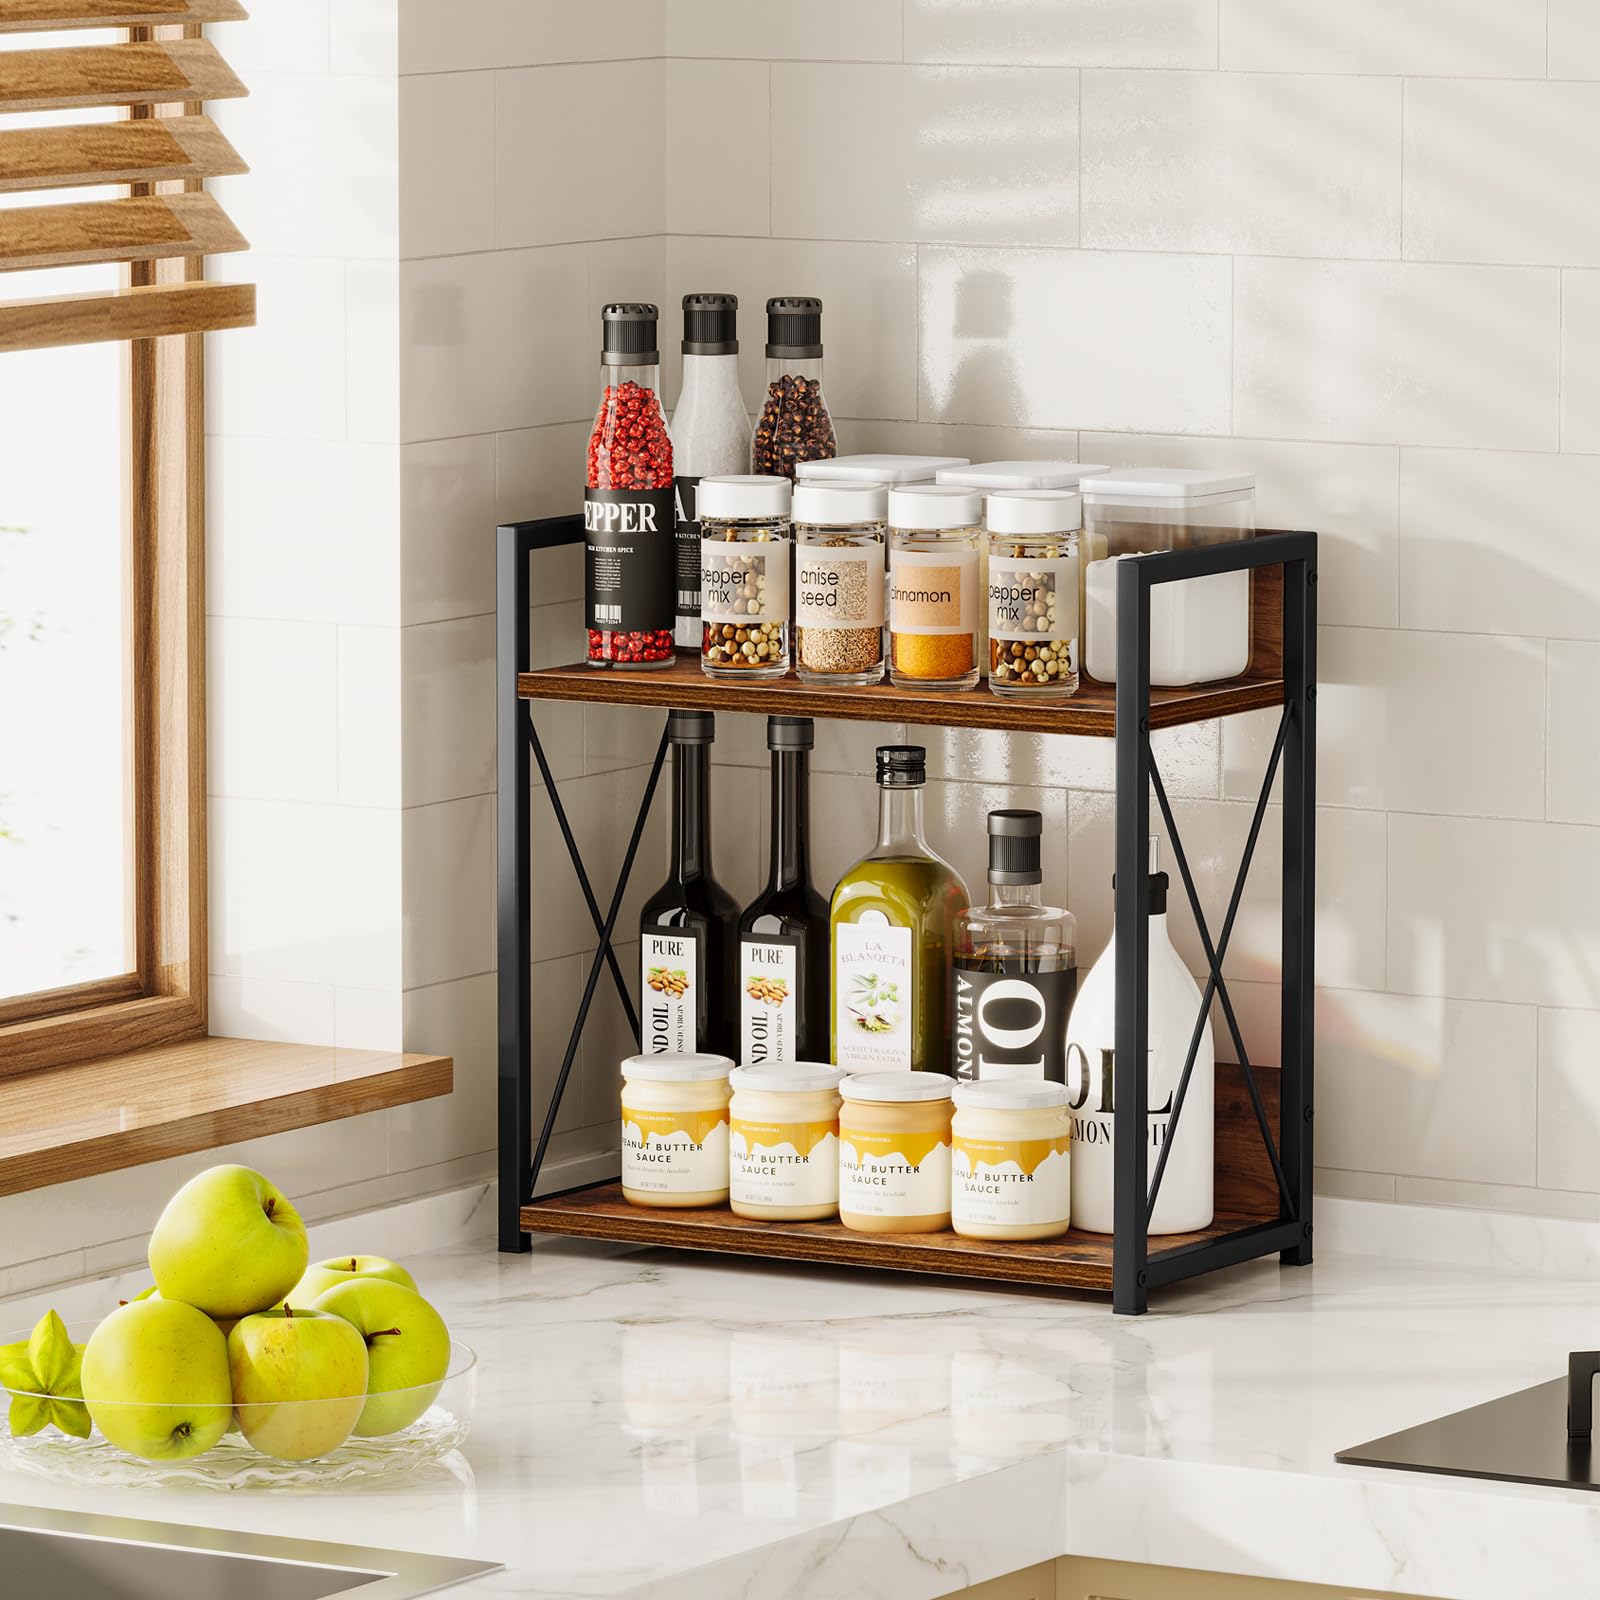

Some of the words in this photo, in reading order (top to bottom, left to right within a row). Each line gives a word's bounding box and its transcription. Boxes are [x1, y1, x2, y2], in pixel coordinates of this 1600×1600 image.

[800, 567, 839, 586] anise
[708, 587, 731, 604] mix
[800, 589, 837, 607] seed
[891, 585, 951, 603] cinnamon
[997, 604, 1019, 621] mix
[652, 939, 684, 956] PURE
[865, 941, 882, 951] LA
[751, 947, 784, 964] PURE
[652, 1002, 669, 1032] OIL
[751, 1011, 768, 1041] OIL
[655, 1143, 703, 1152] BUTTER
[636, 1152, 672, 1163] SAUCE
[760, 1155, 809, 1164] BUTTER
[741, 1164, 777, 1176] SAUCE
[871, 1165, 920, 1174] BUTTER
[851, 1174, 887, 1186] SAUCE
[984, 1173, 1034, 1183] BUTTER
[964, 1183, 1001, 1194] SAUCE
